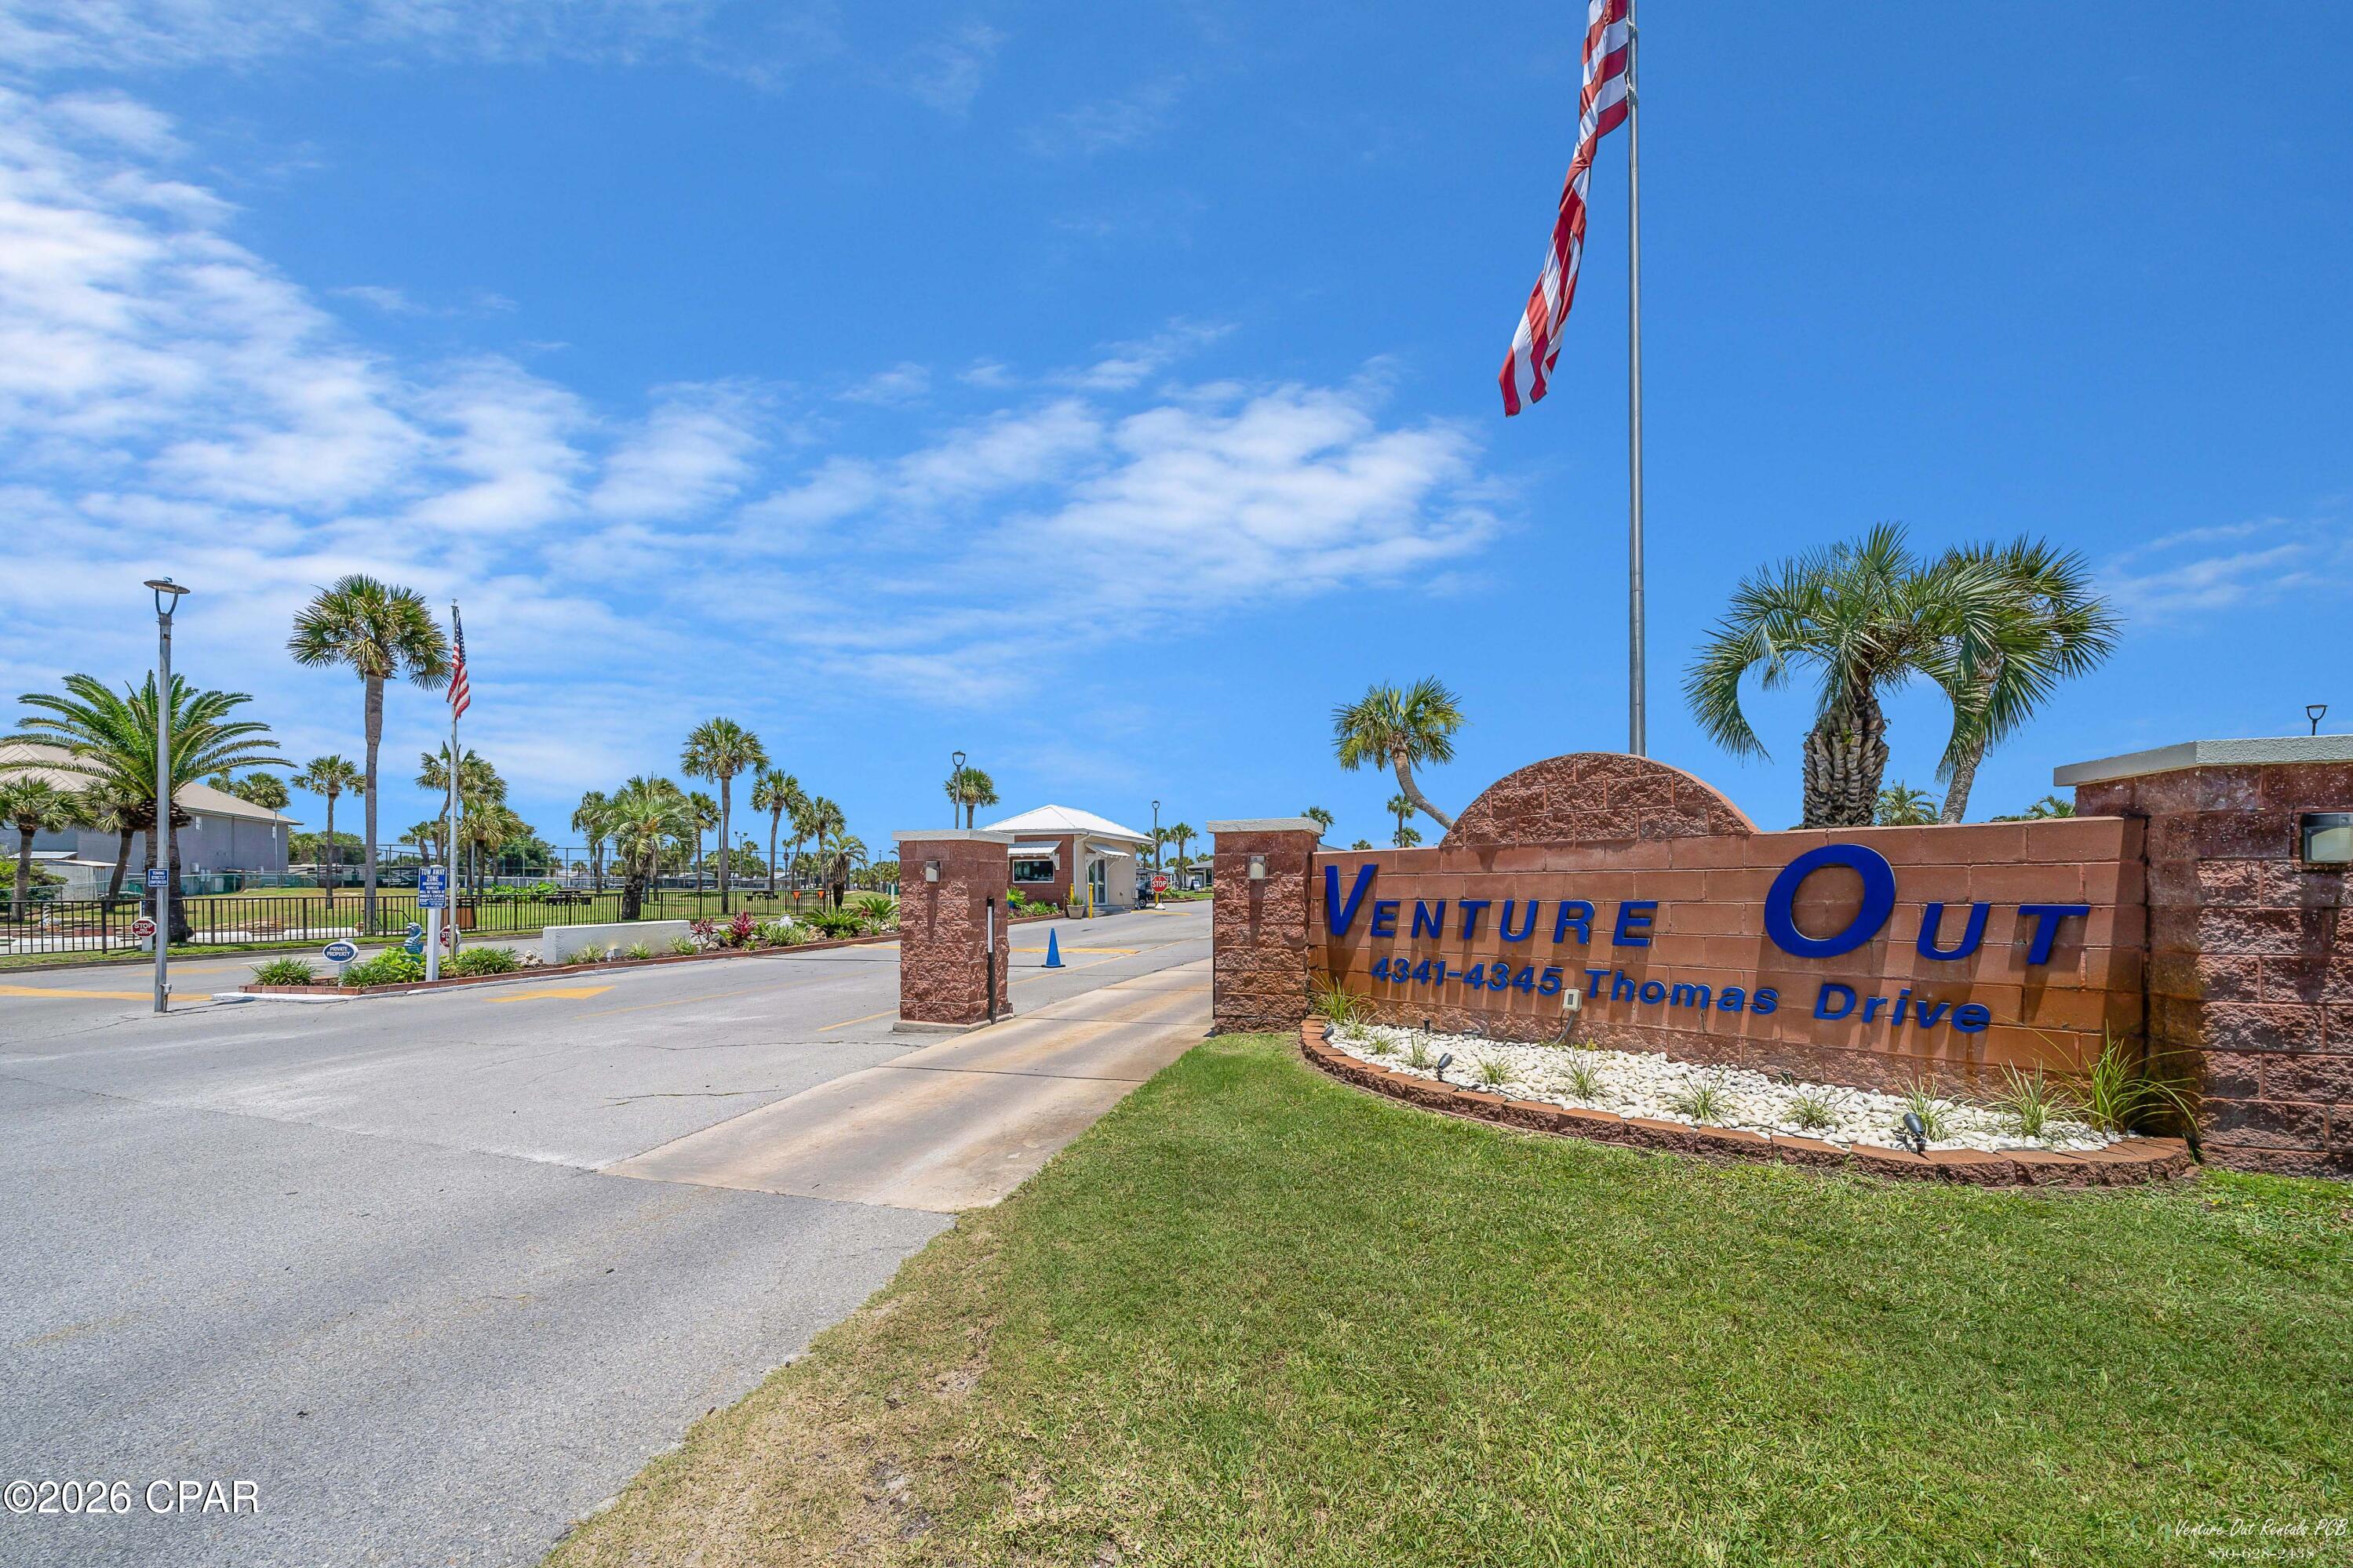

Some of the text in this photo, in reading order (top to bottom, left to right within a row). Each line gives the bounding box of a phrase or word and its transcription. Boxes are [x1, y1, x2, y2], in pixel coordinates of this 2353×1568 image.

[1324, 843, 2091, 966] VENTURE OUT
[1371, 956, 1991, 1033] 4341-4345 Thomas Drive
